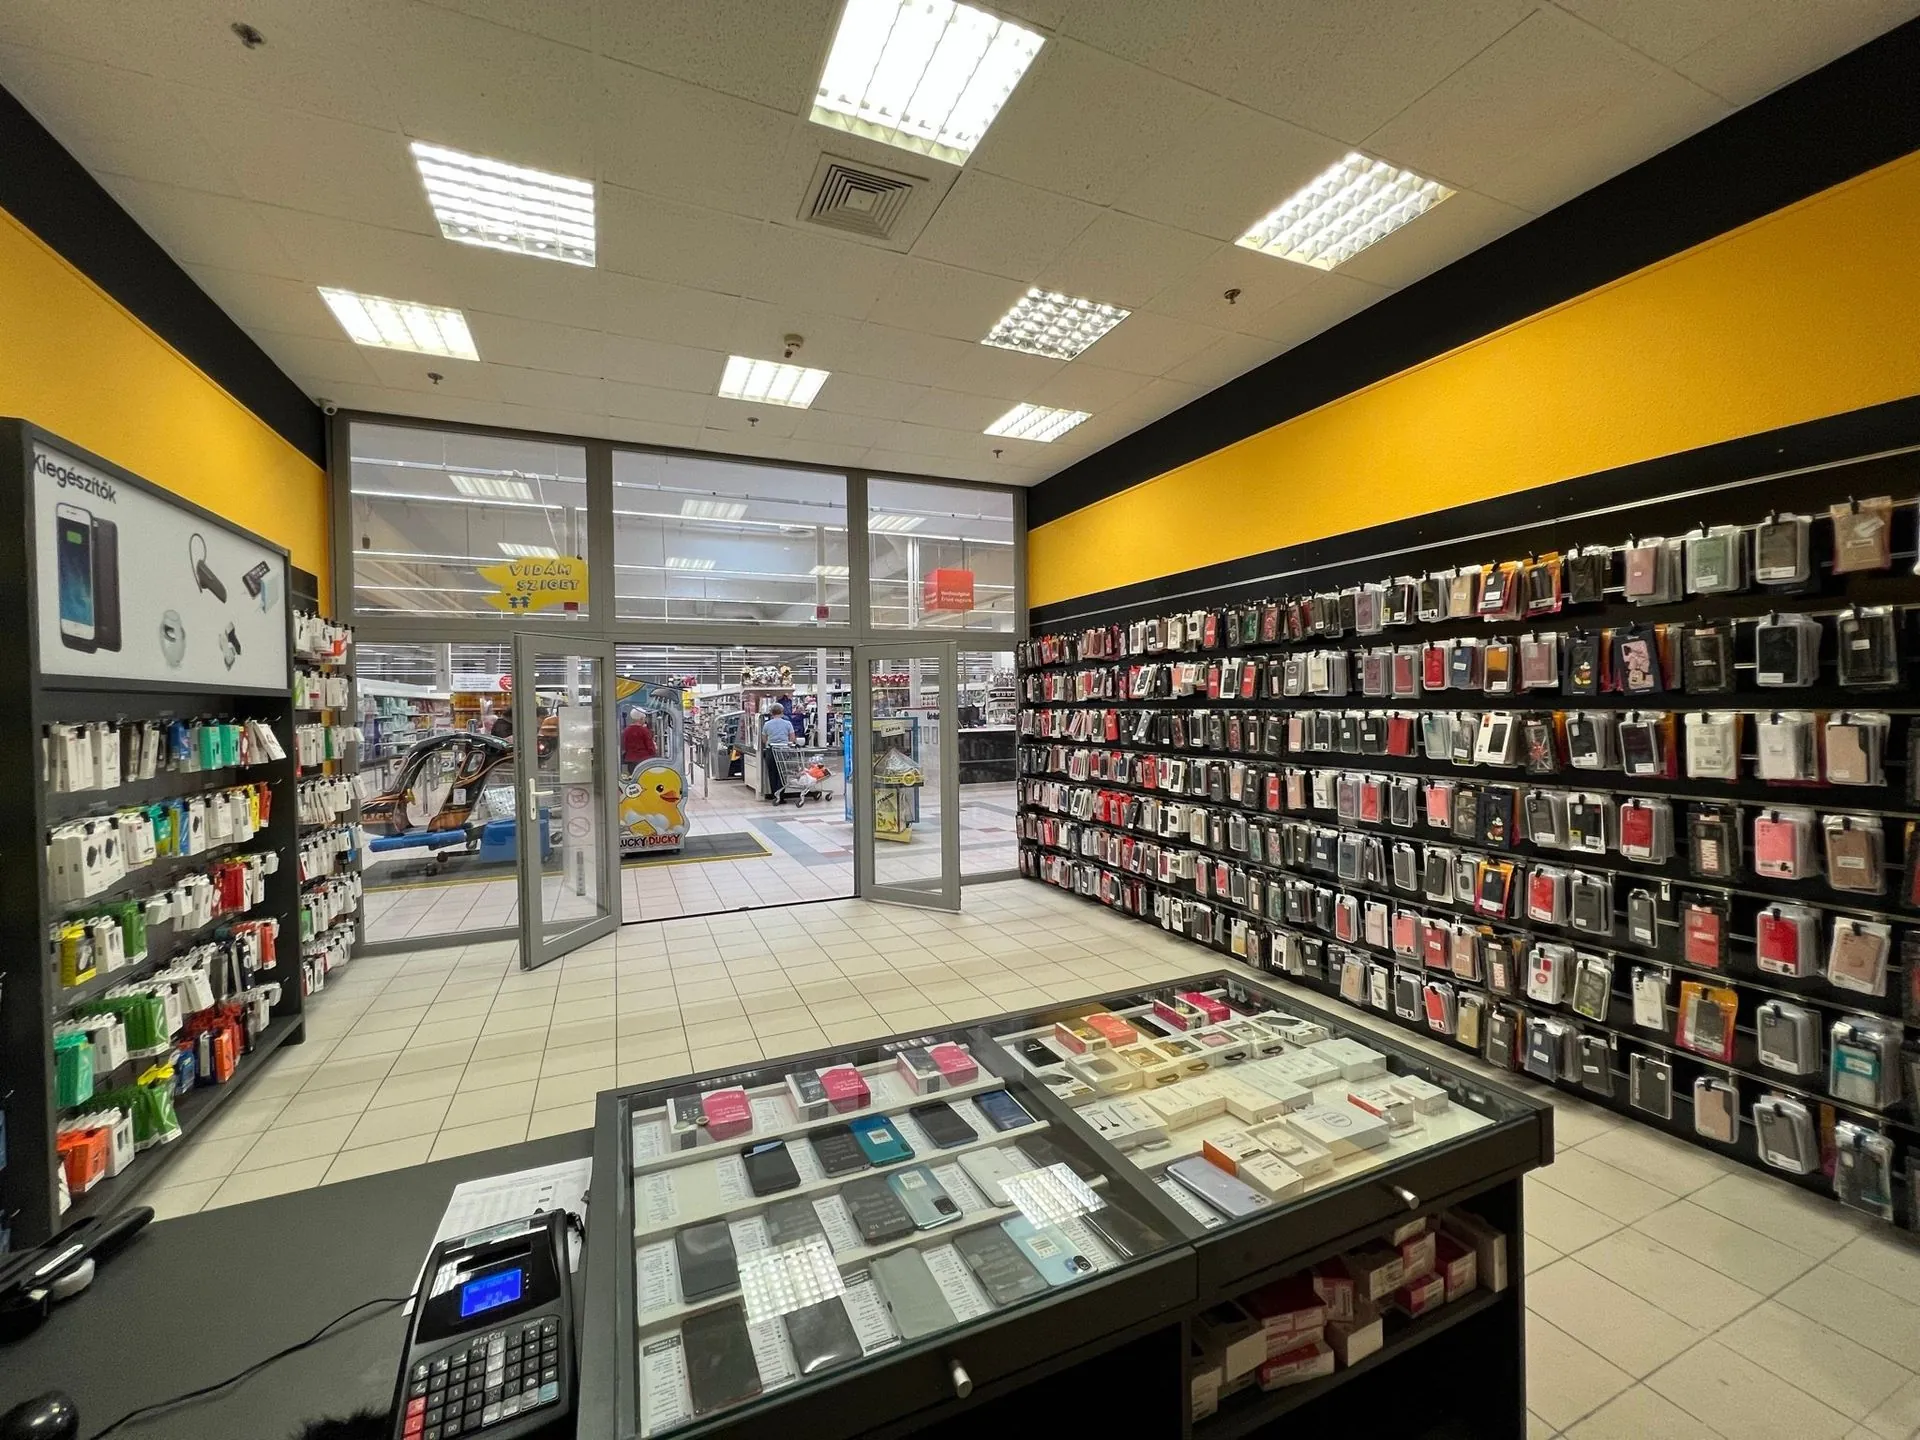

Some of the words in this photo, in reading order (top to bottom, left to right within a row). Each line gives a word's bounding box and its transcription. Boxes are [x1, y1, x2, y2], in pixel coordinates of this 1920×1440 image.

[509, 560, 572, 577] VIDÁM
[516, 580, 580, 592] SZIGET
[620, 837, 646, 848] UCKY
[648, 834, 680, 846] DUCKY
